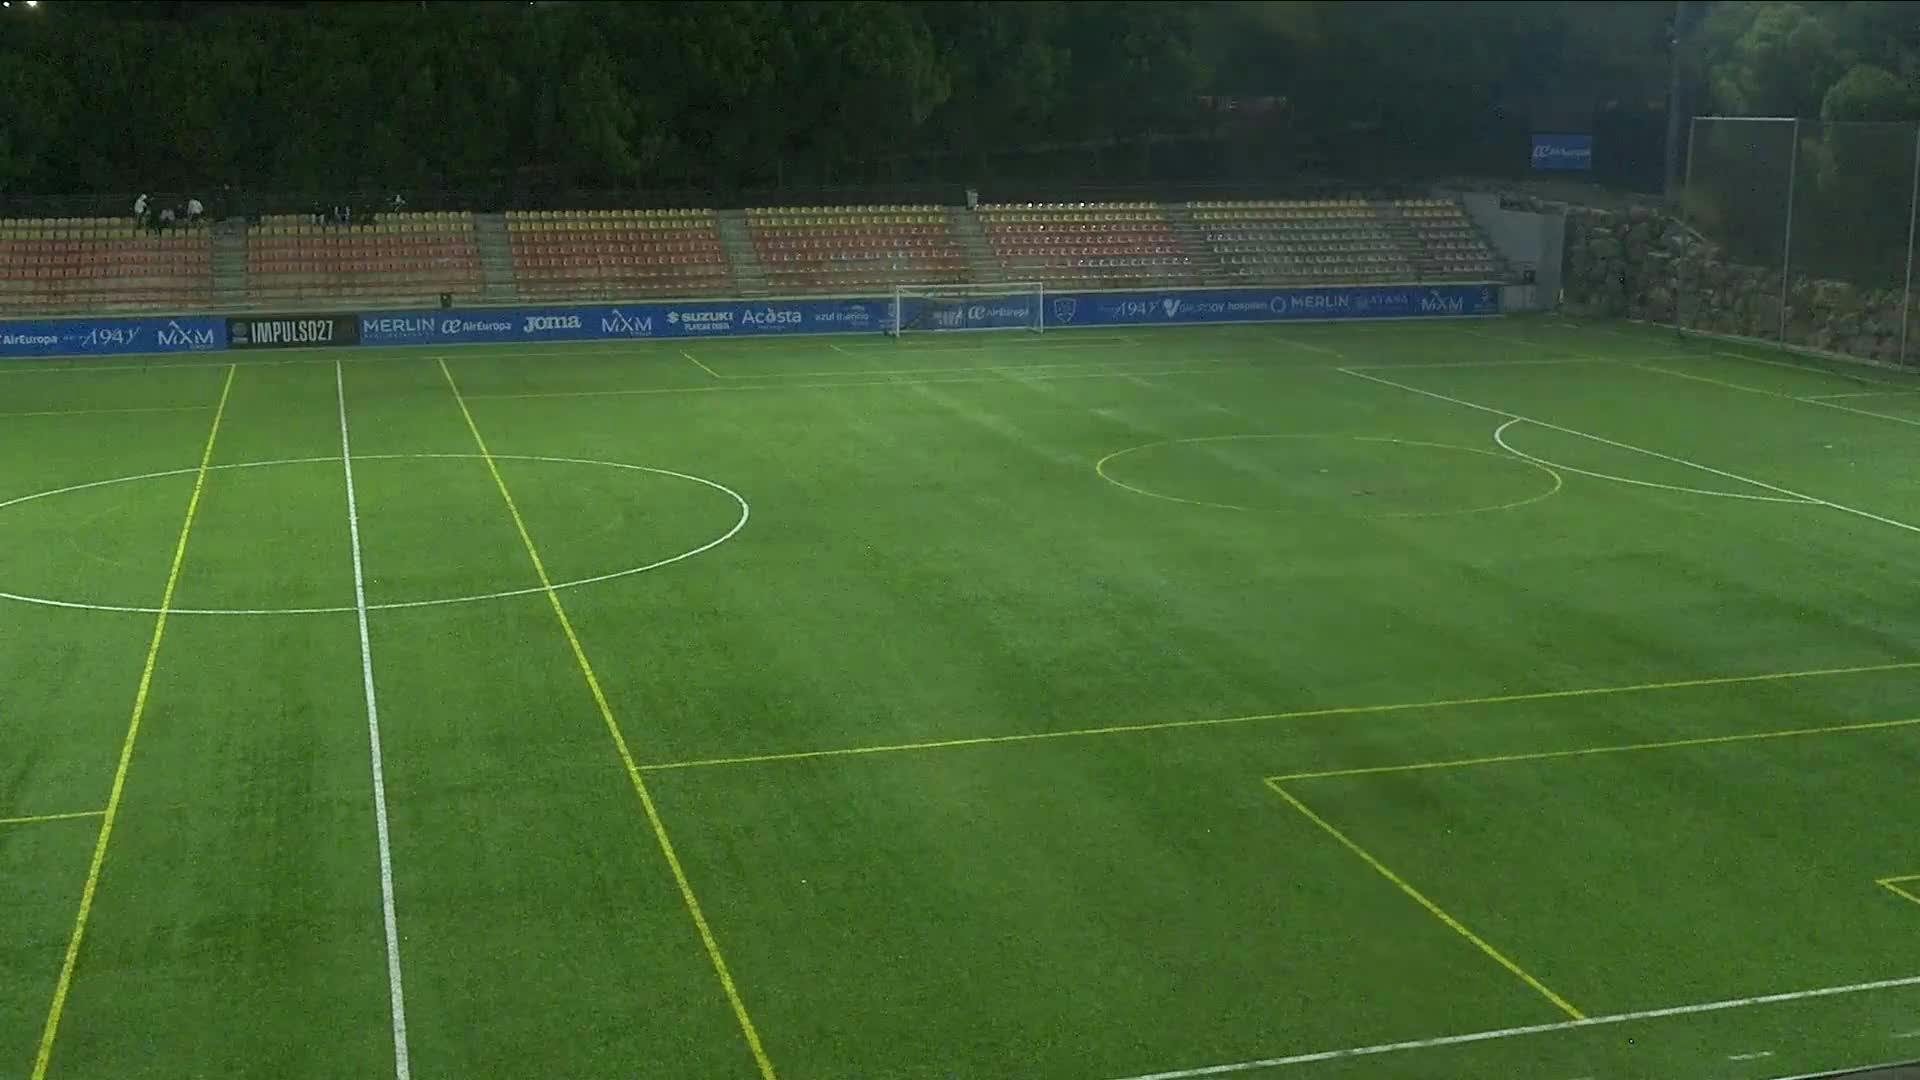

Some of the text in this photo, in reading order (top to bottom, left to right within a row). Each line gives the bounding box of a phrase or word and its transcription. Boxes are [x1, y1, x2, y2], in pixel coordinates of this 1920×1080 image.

[1291, 295, 1349, 308] MERLIN
[681, 312, 733, 322] SUZUKI
[363, 318, 435, 332] MERLIN
[463, 321, 512, 333] AirEuropa
[3, 335, 58, 345] AirEuropa
